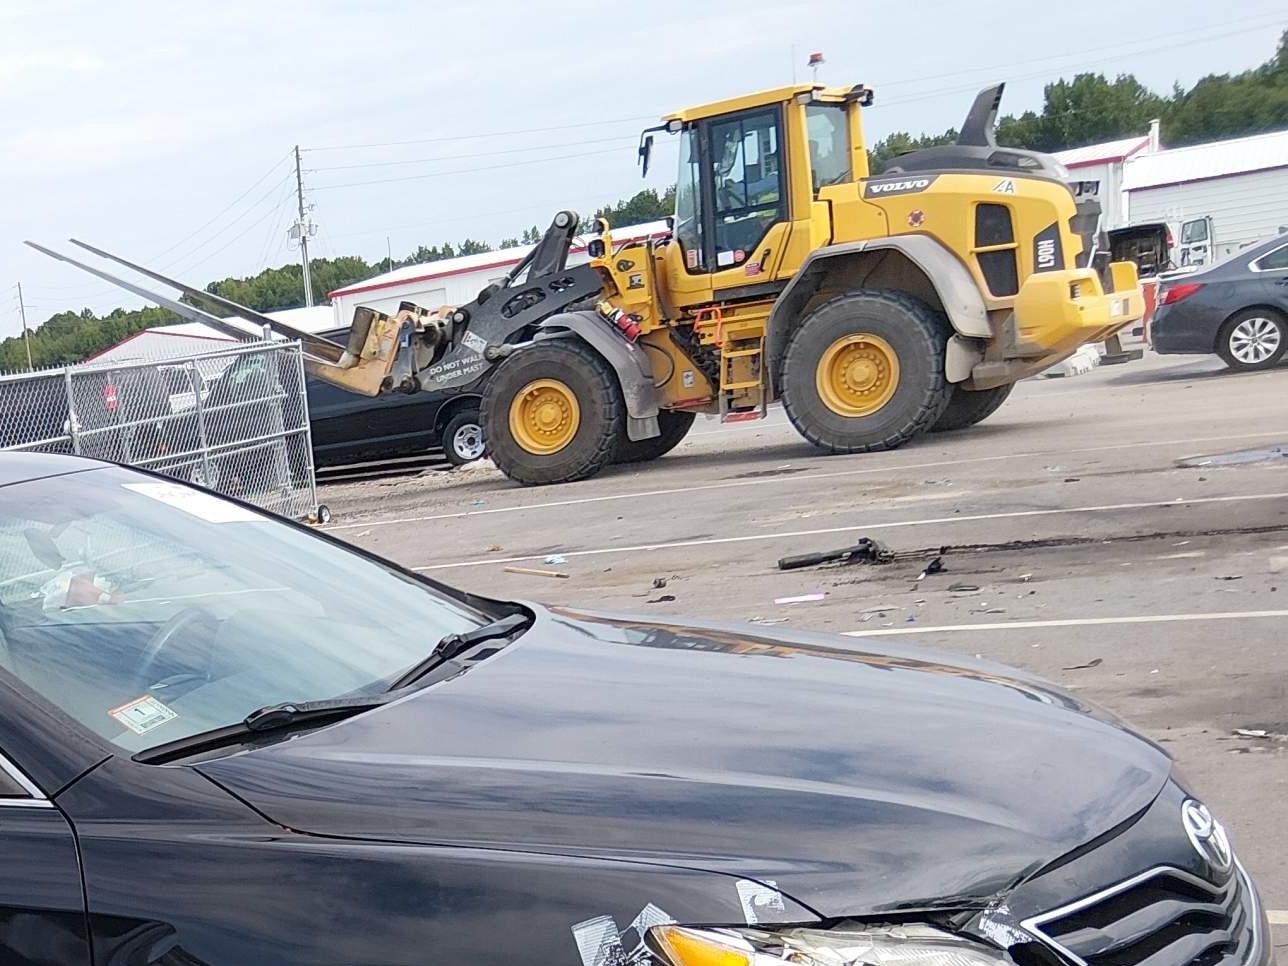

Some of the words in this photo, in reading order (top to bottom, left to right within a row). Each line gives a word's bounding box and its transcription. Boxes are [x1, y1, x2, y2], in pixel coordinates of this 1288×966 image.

[870, 179, 929, 193] VOLVO
[1037, 239, 1054, 268] L90H
[430, 366, 442, 375] DO
[443, 360, 460, 370] NOT
[437, 370, 462, 382] UNDER
[463, 364, 483, 374] MAST
